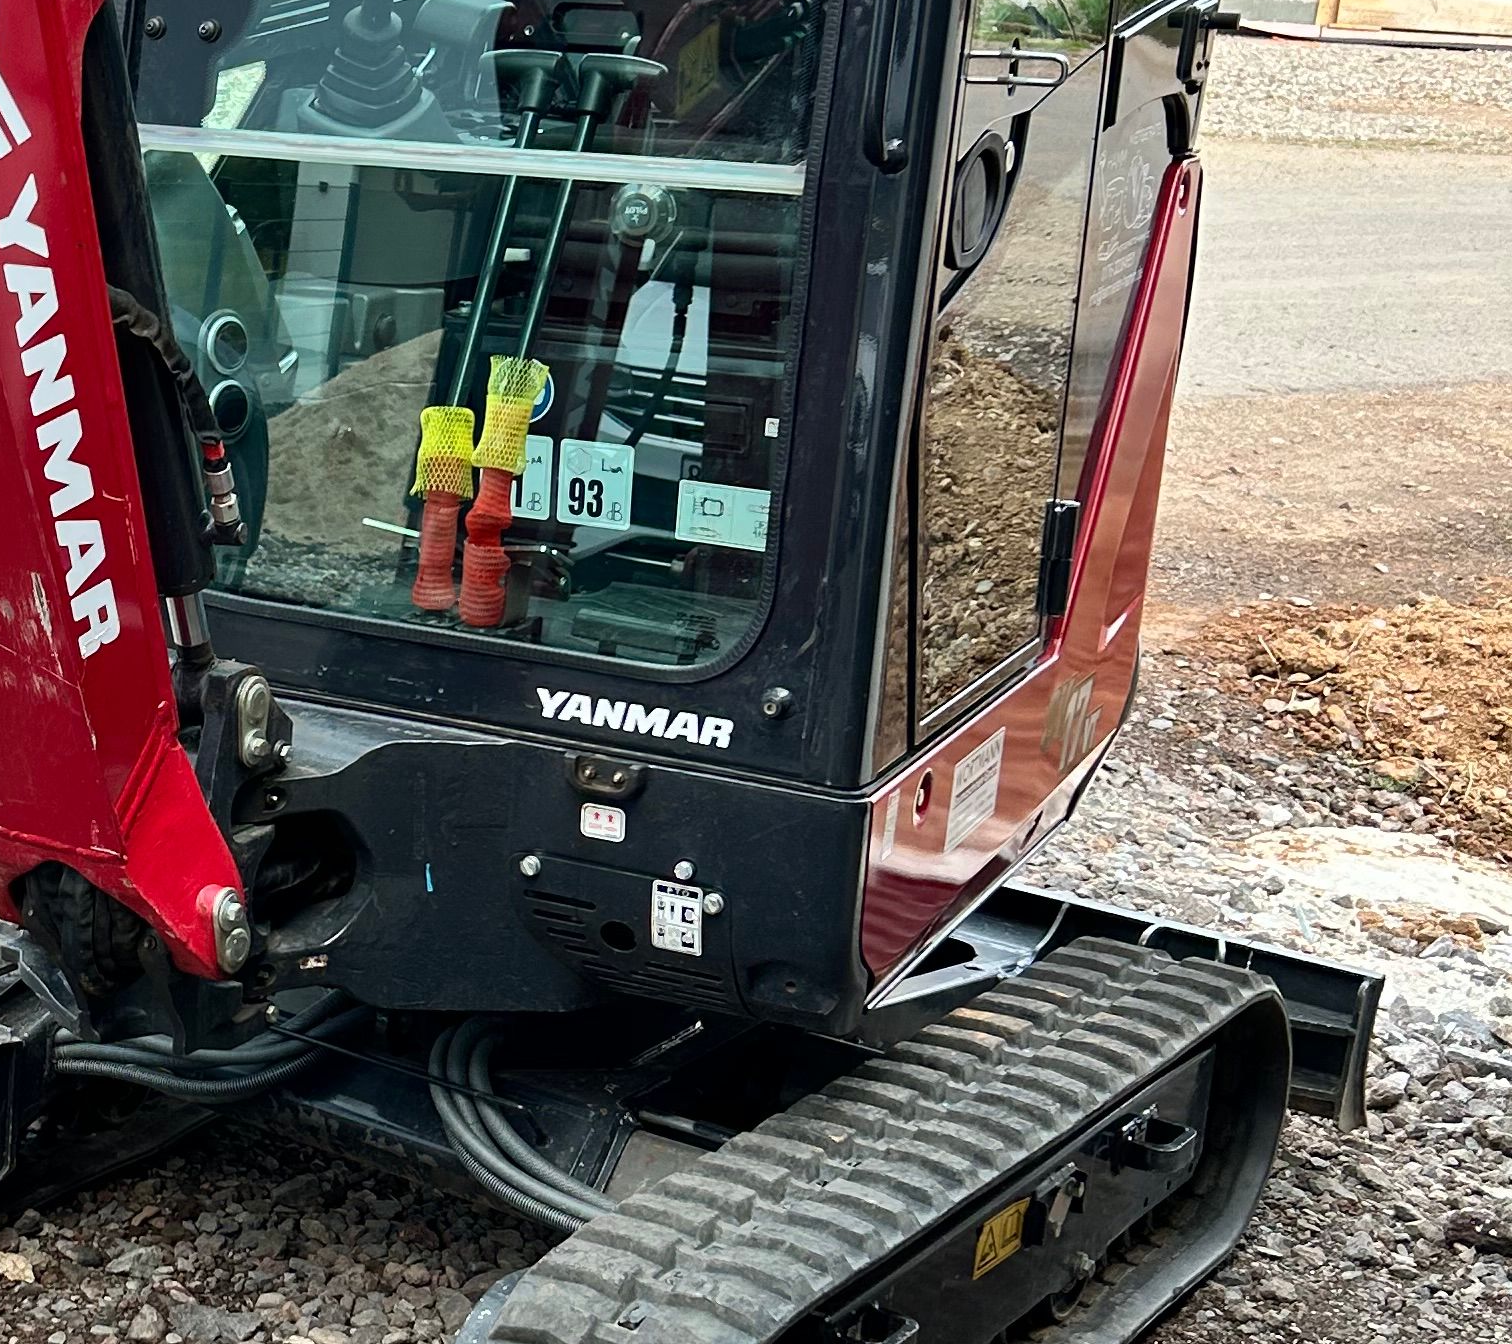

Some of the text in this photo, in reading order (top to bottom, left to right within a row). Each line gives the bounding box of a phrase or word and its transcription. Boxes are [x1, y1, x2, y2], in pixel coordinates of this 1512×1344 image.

[526, 492, 542, 511] dB
[568, 477, 623, 521] 93 dB
[536, 687, 734, 749] YANMAR
